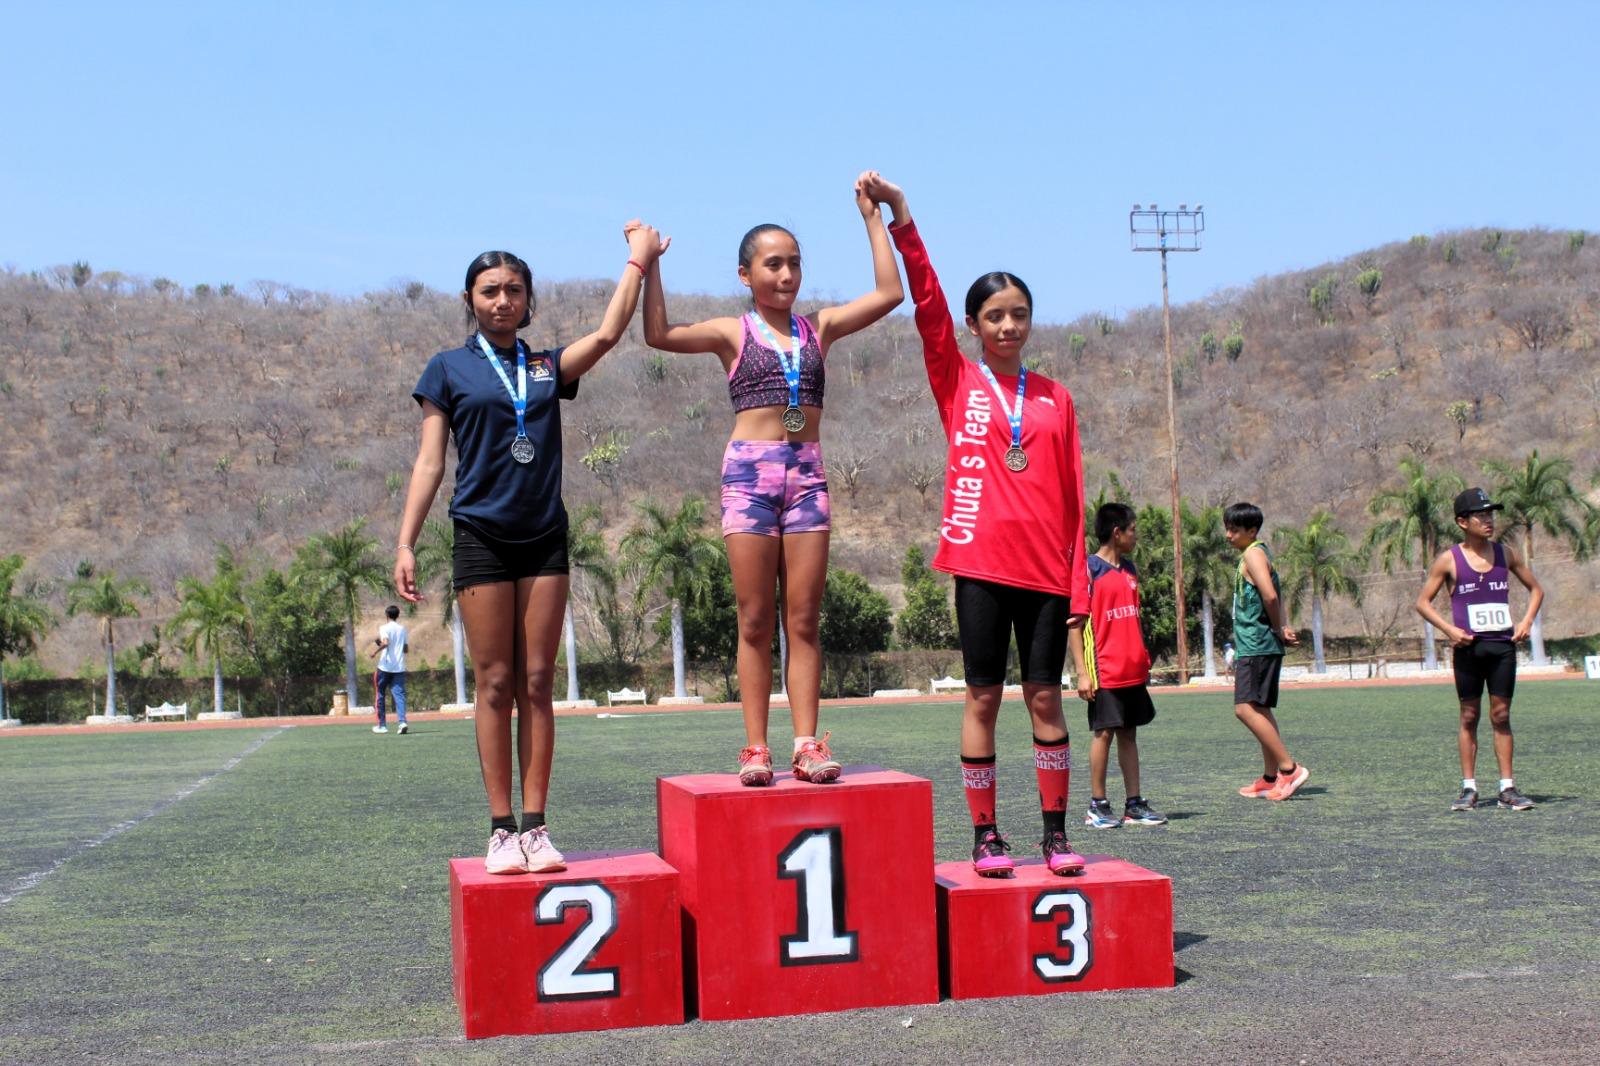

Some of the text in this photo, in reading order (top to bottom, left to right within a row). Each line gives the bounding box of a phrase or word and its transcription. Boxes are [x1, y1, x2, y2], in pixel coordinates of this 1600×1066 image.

[955, 390, 991, 446] Team
[1475, 610, 1506, 626] 510
[780, 830, 857, 961] 1
[1033, 891, 1091, 980] 3
[536, 882, 618, 999] 2
